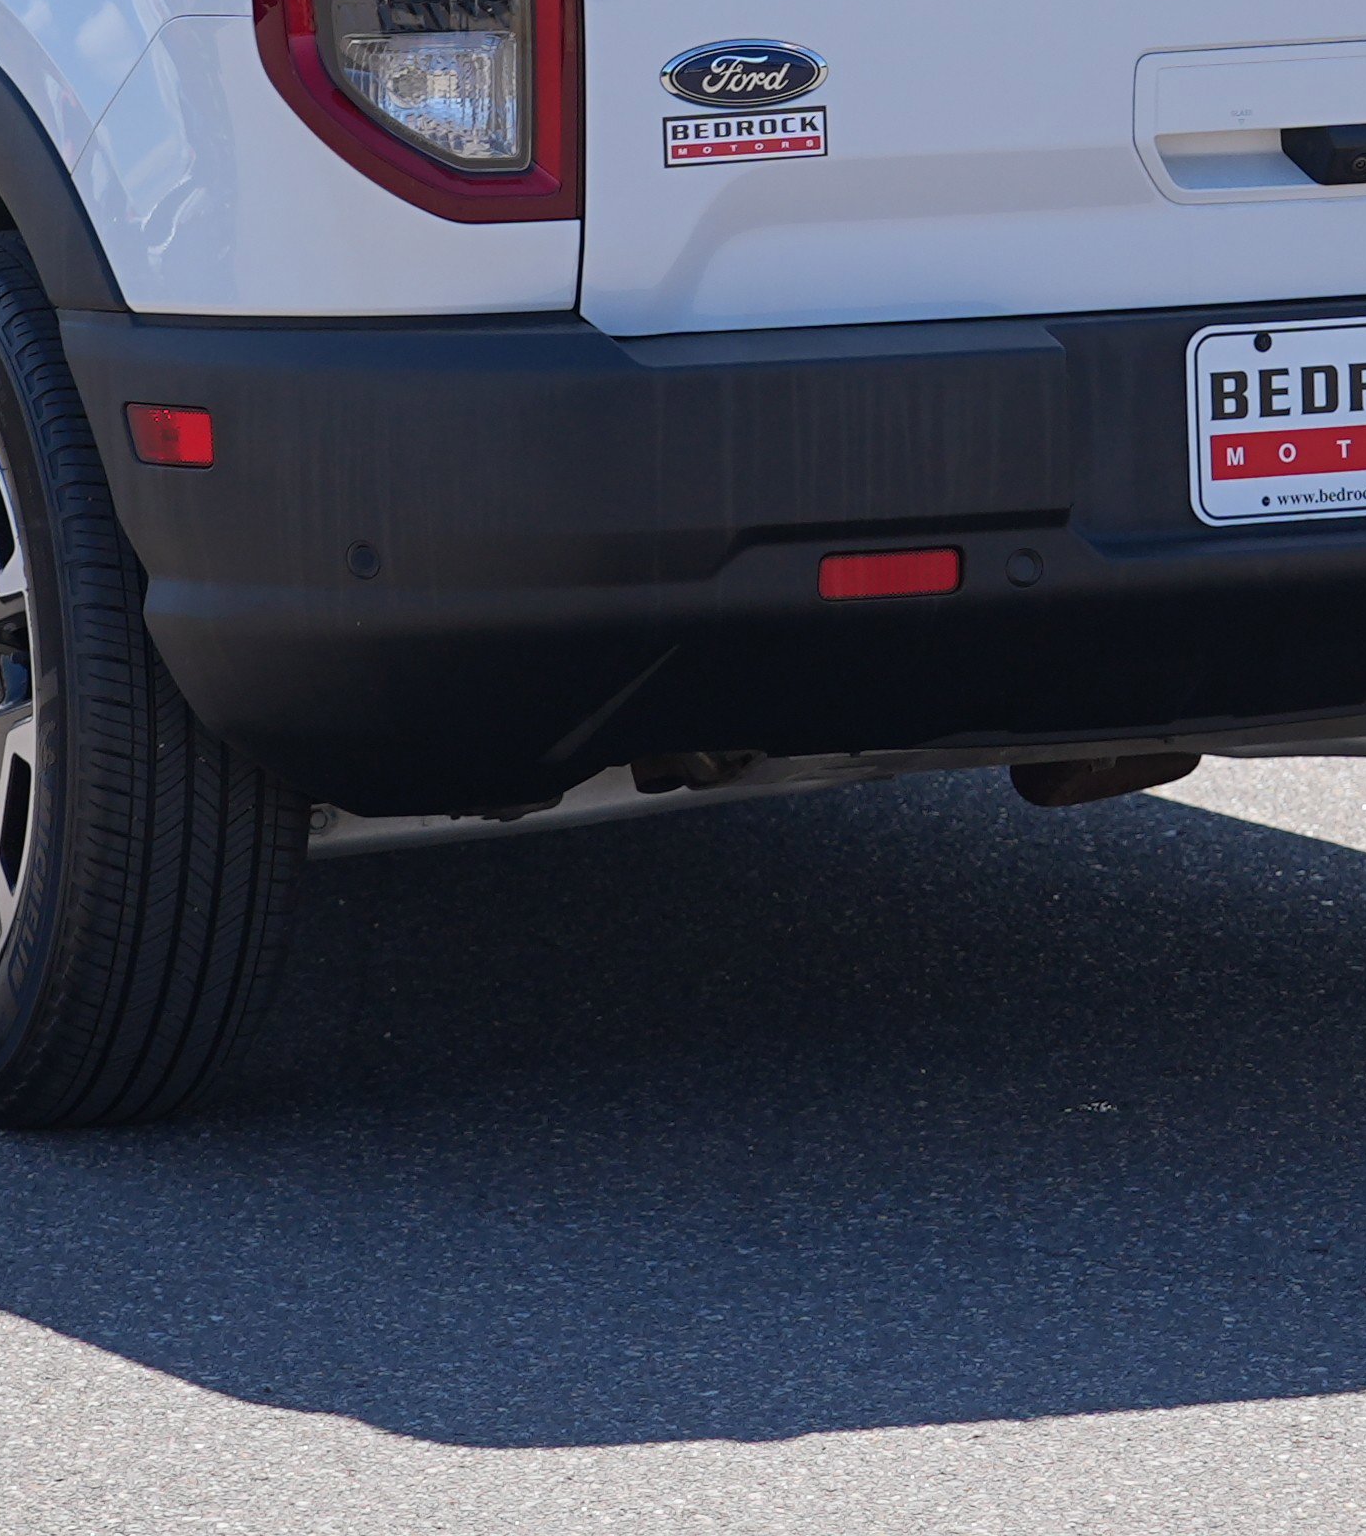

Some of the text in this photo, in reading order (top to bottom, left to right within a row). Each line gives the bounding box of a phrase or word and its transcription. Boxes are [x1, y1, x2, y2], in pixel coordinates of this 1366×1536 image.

[701, 54, 791, 95] Ford
[670, 115, 820, 141] BEDROCK
[677, 139, 815, 156] MOTORS
